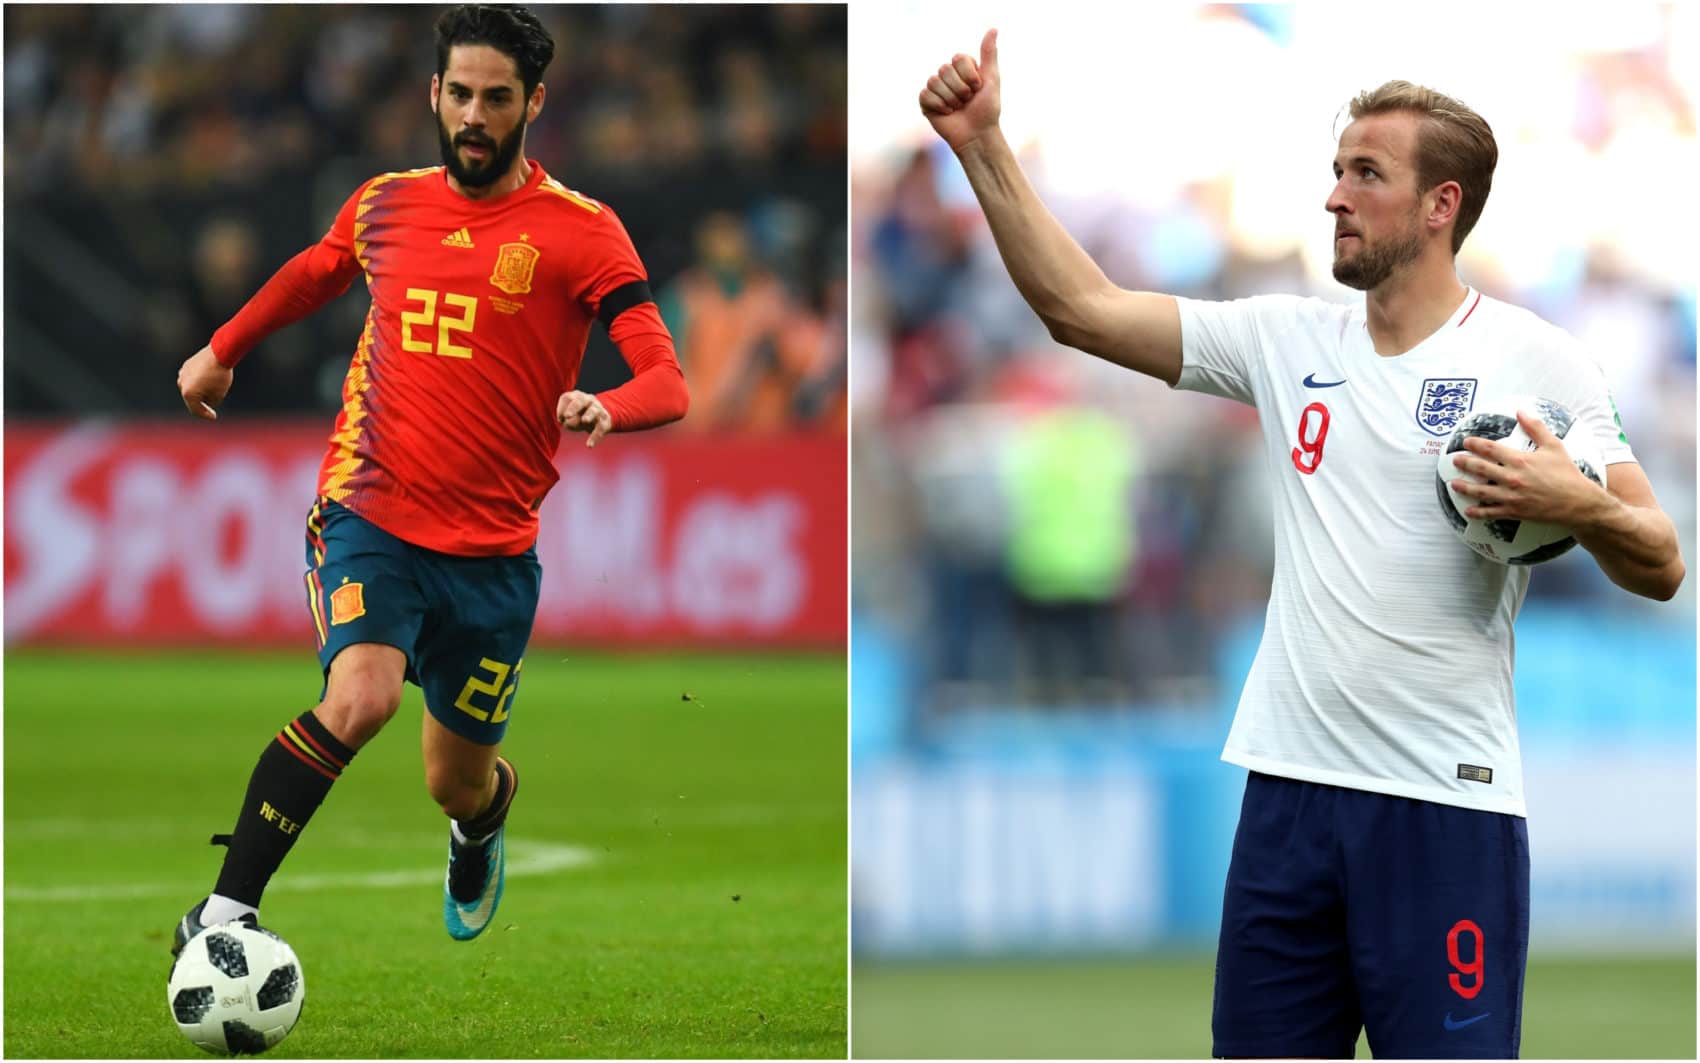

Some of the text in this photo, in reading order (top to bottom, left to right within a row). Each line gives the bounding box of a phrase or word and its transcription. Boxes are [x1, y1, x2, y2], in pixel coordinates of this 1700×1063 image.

[441, 239, 475, 249] adidas
[401, 288, 478, 359] 22
[1292, 402, 1331, 475] 9
[259, 801, 300, 834] RFEF
[1447, 919, 1484, 999] 9
